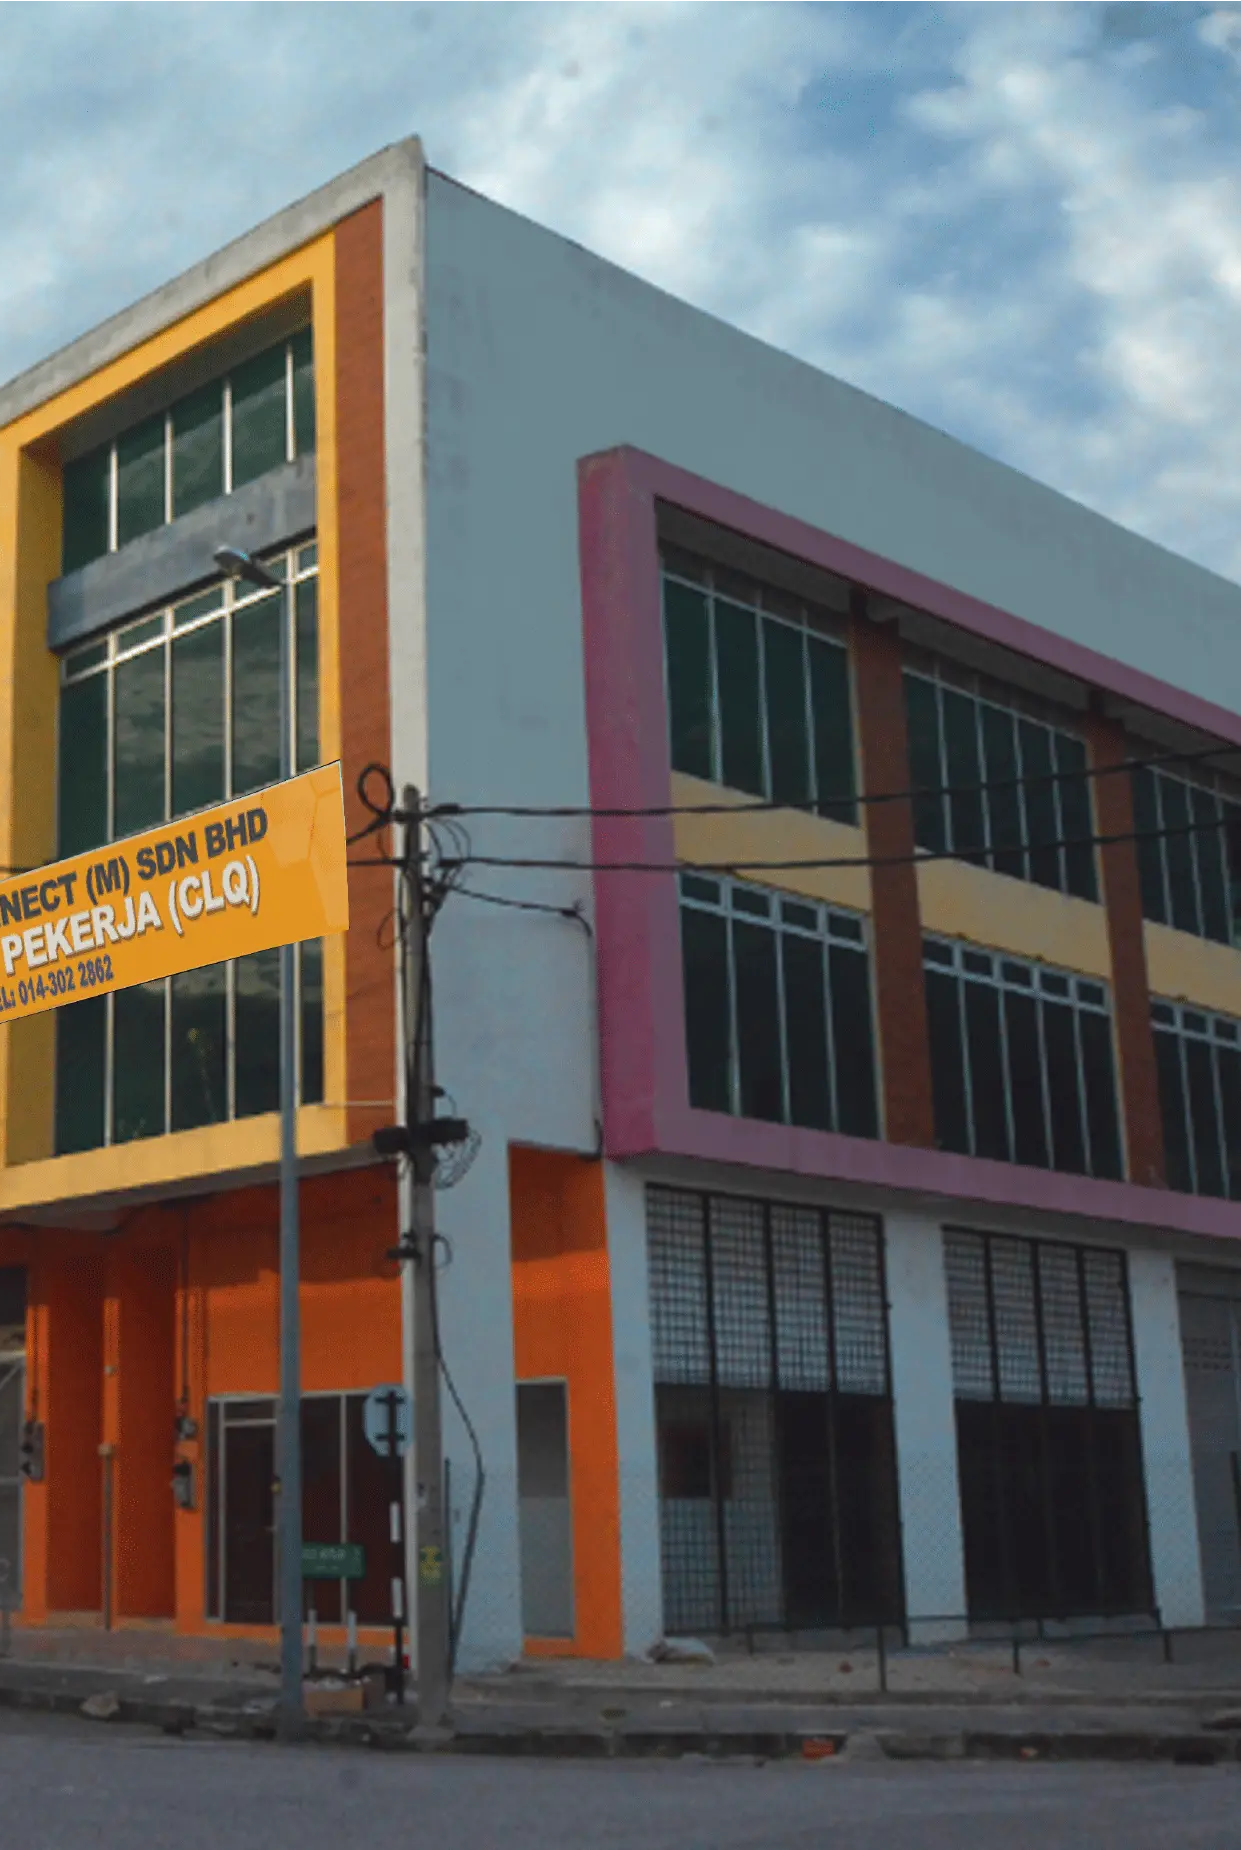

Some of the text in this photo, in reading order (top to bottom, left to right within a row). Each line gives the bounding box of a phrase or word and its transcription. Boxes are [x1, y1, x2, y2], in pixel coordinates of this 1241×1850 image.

[86, 856, 130, 905] (M)
[136, 831, 199, 880] SDN
[204, 807, 268, 858] BHD
[1, 891, 163, 977] PEKERJA
[168, 855, 260, 936] (CLQ)
[18, 966, 76, 1006] 014-302
[78, 954, 114, 988] 2862
